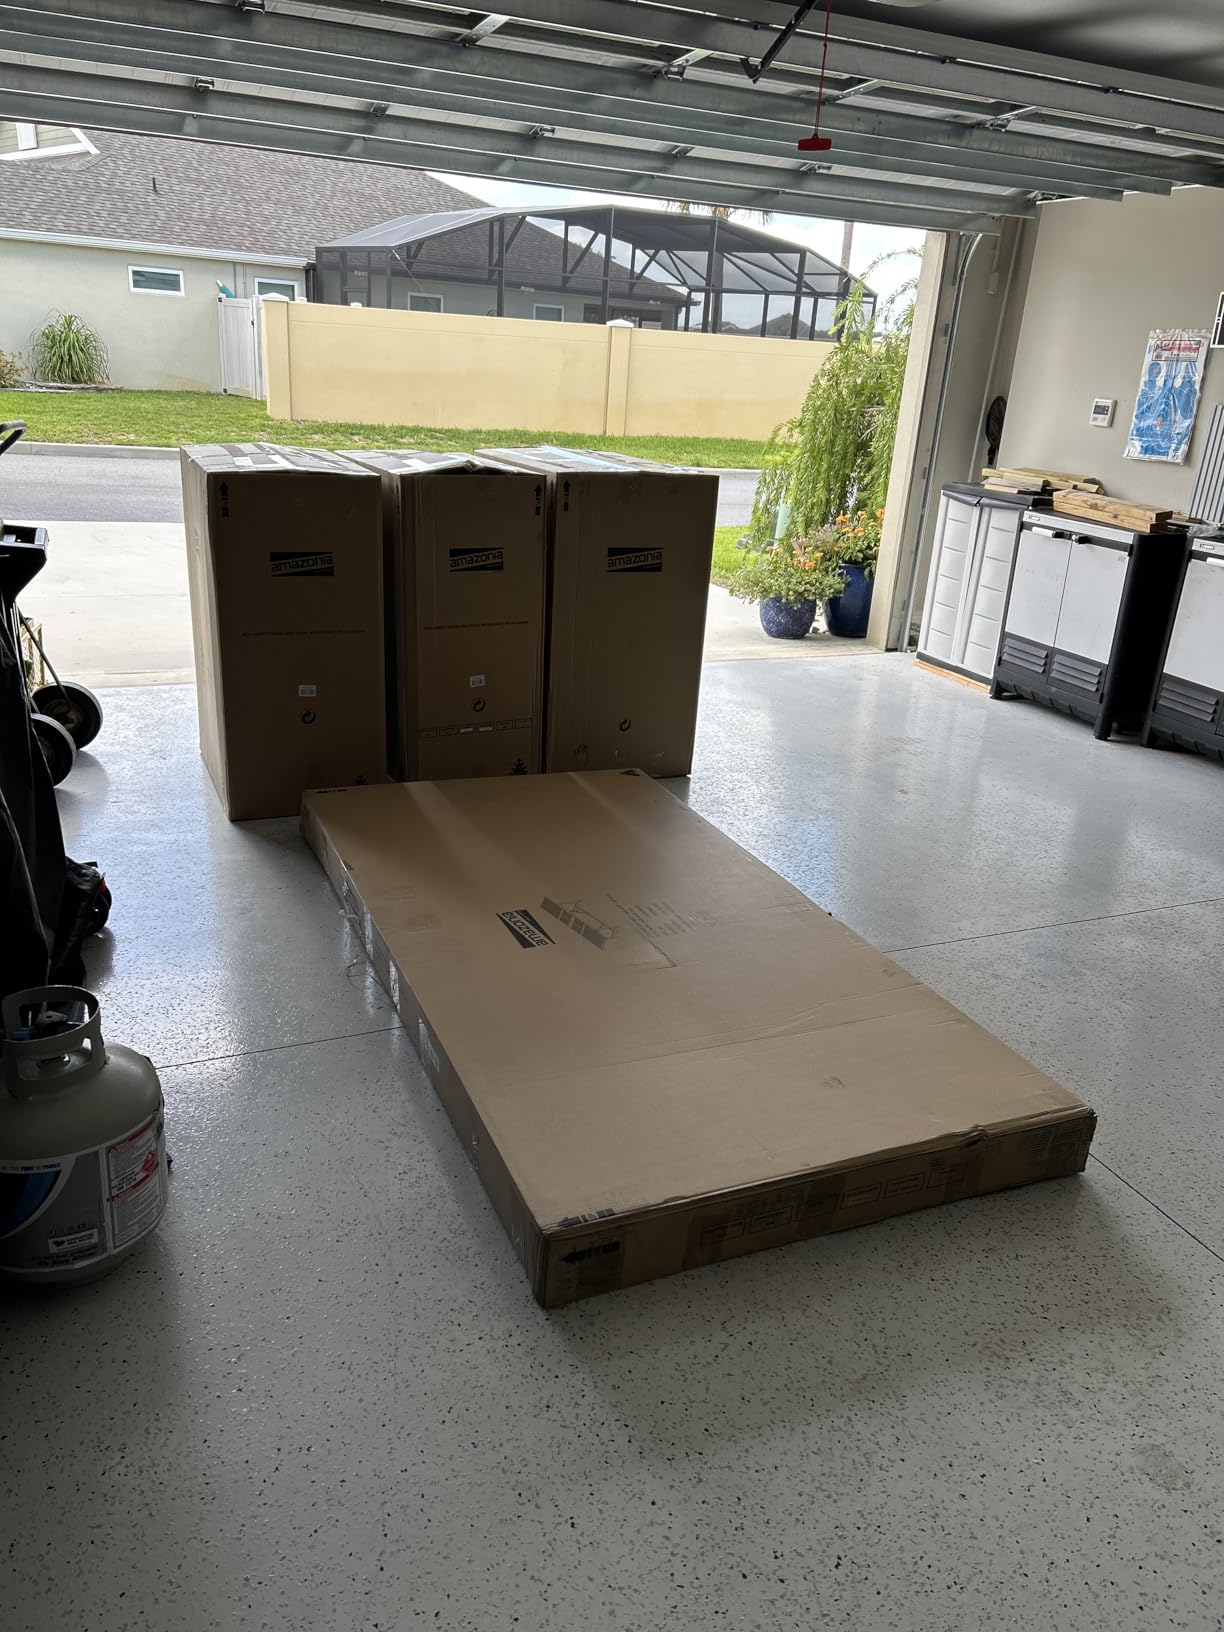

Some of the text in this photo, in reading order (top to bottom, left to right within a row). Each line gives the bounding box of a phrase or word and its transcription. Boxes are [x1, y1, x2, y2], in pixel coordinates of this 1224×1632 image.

[272, 555, 333, 572] amazonia
[449, 551, 503, 568] amazonia
[608, 551, 662, 567] amazonia
[502, 911, 549, 947] amazonia
